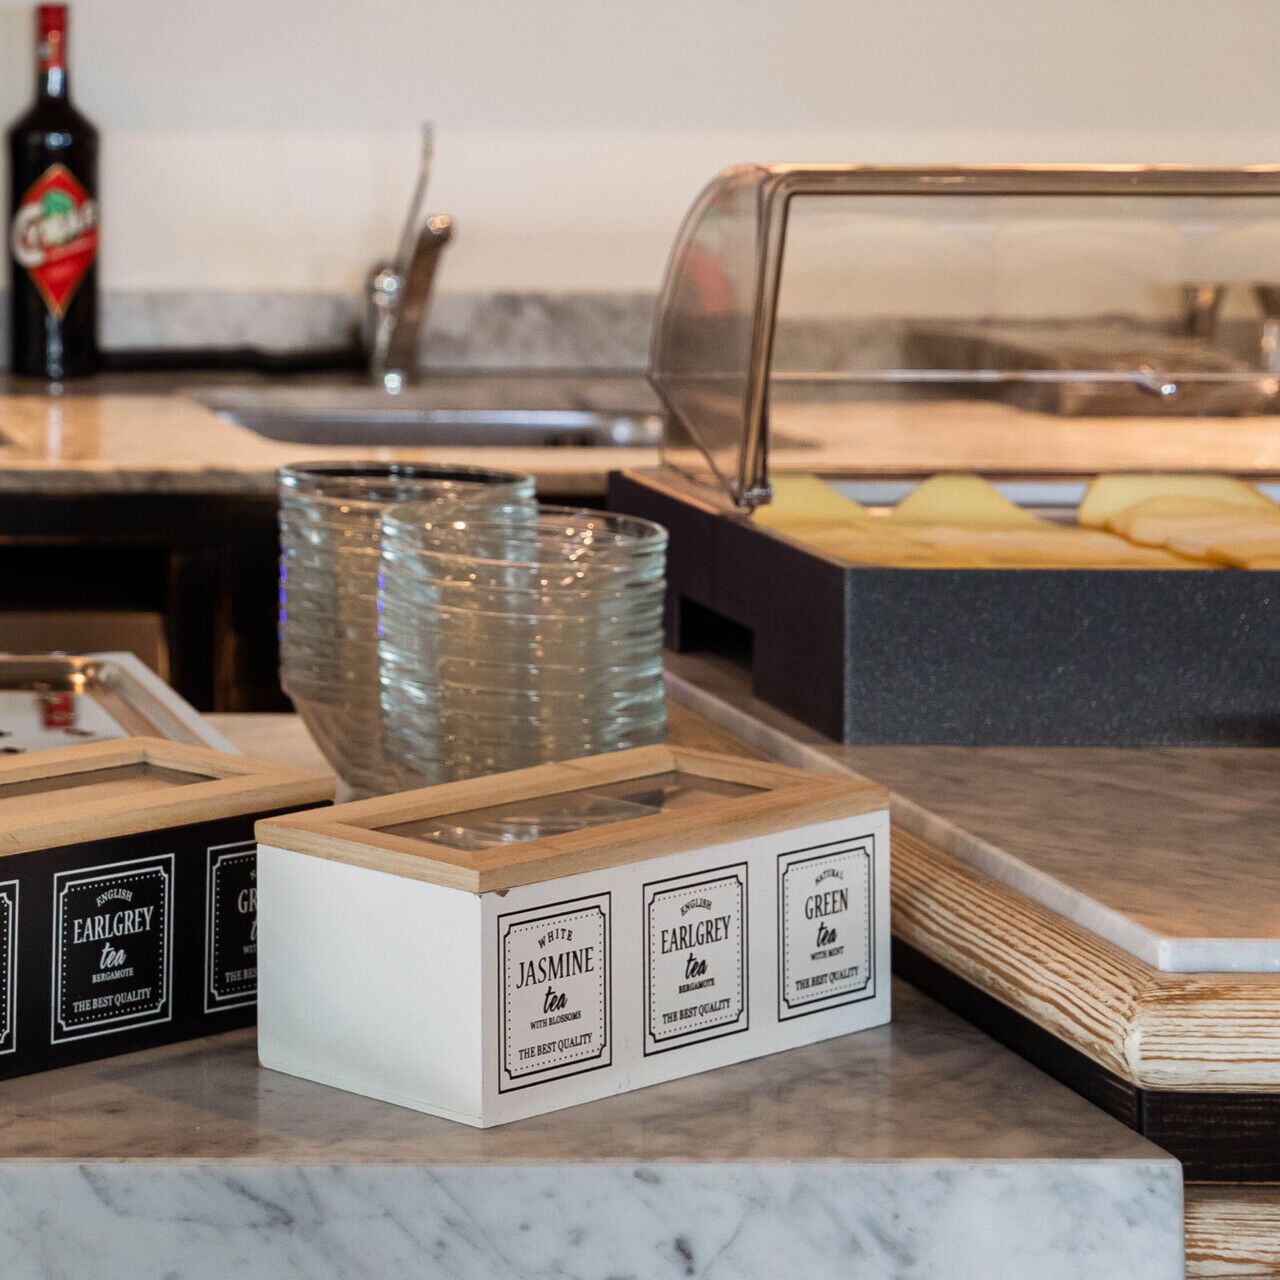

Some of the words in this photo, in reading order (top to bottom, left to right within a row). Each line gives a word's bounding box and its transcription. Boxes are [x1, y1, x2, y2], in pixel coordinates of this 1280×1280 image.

[815, 868, 844, 885] NATURAL
[96, 888, 133, 907] ENGLISH
[680, 898, 712, 916] ENGLISH
[805, 888, 848, 920] GREEN
[73, 906, 154, 944] EARLGREY
[661, 915, 731, 954] EARLGREY
[816, 921, 837, 948] tea
[538, 928, 573, 949] WHITE
[100, 941, 127, 969] tea
[685, 952, 708, 979] tea
[811, 951, 827, 961] WITH
[828, 946, 844, 957] MINT
[92, 967, 134, 983] BERGAMOTE
[225, 970, 242, 982] THE
[243, 968, 257, 978] BES
[516, 946, 595, 989] JASMINE
[795, 979, 810, 991] THE
[811, 974, 828, 987] BEST
[829, 966, 859, 983] QUALITY
[678, 977, 715, 994] BERGAMOTE
[73, 1000, 91, 1012] THE
[92, 995, 113, 1009] BEST
[114, 987, 152, 1006] QUALITY
[543, 985, 568, 1014] tea
[662, 1011, 678, 1024] THE
[679, 1006, 697, 1020] BEST
[698, 998, 731, 1017] QUALITY
[530, 1019, 548, 1030] WITH
[548, 1010, 581, 1026] BLOSSOMS
[518, 1047, 536, 1060] THE
[536, 1041, 557, 1056] BEST
[558, 1032, 592, 1052] QUALITY
